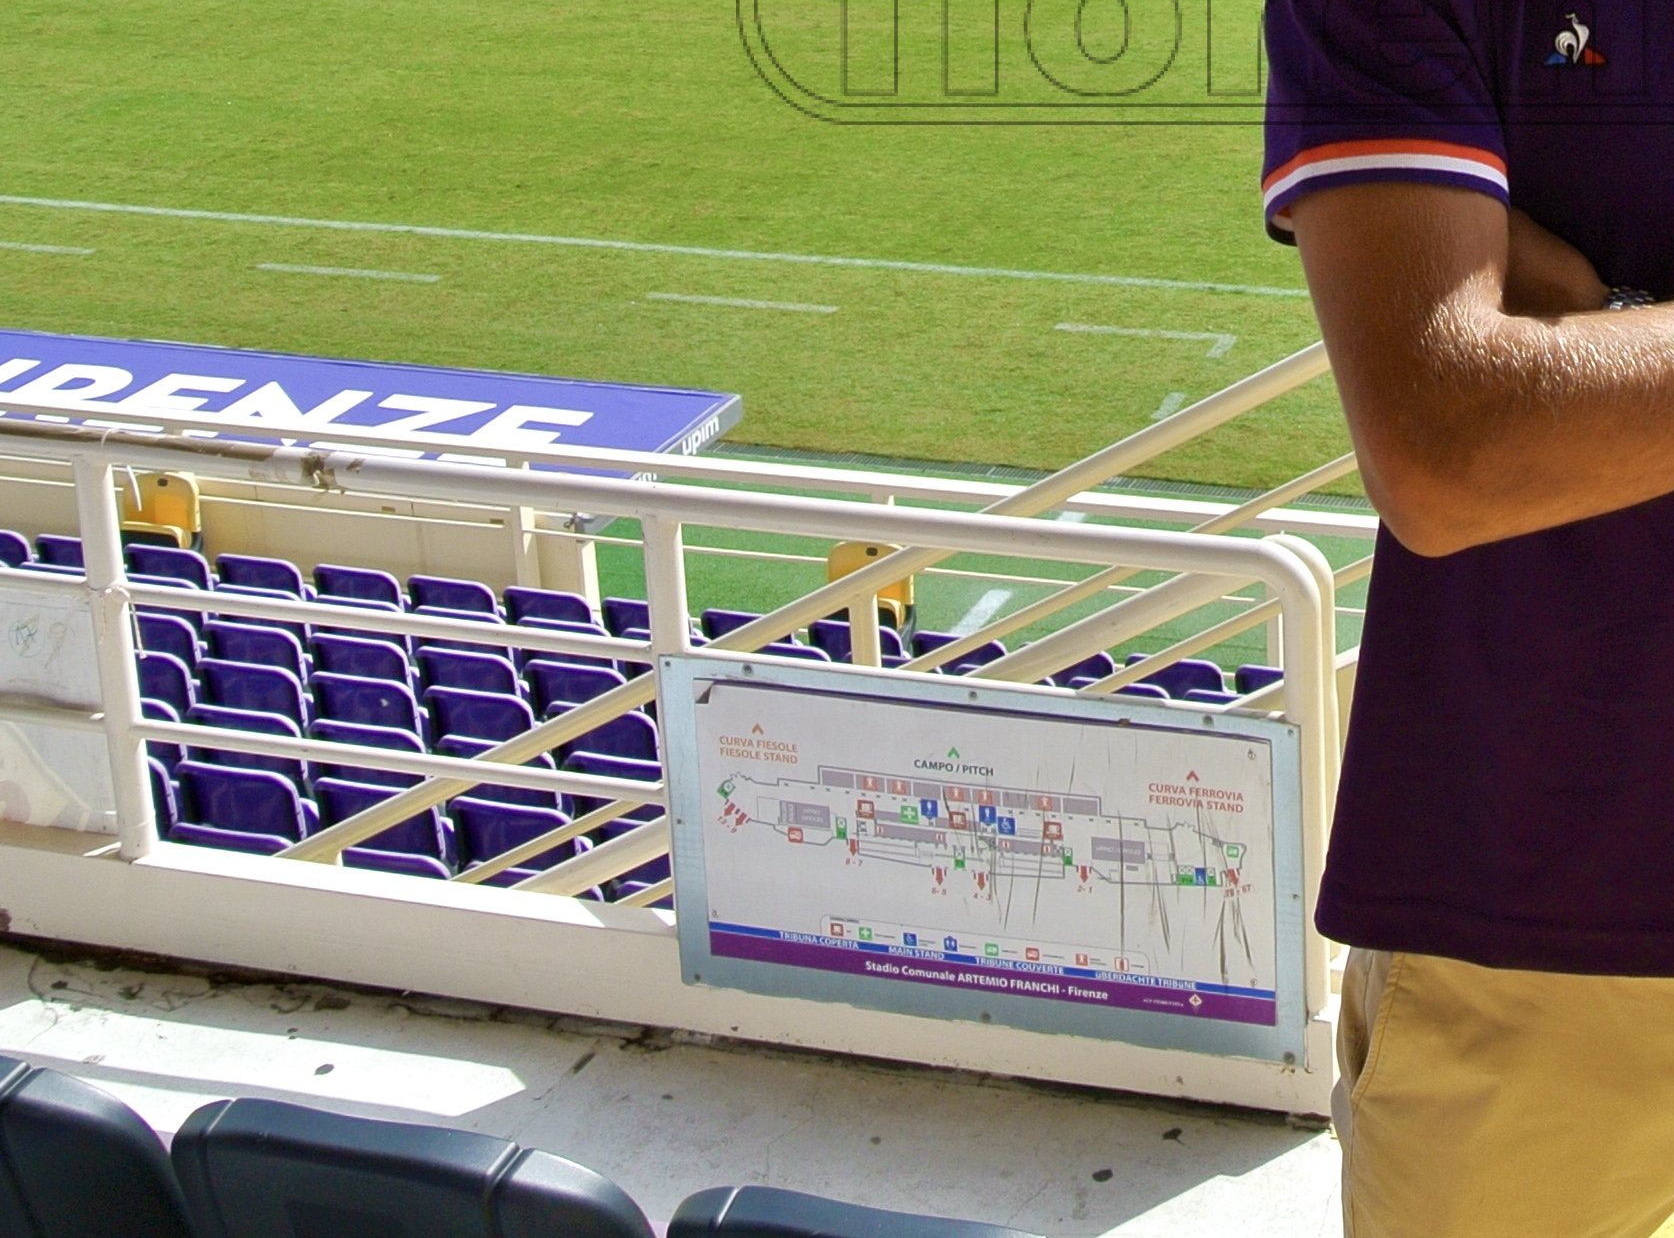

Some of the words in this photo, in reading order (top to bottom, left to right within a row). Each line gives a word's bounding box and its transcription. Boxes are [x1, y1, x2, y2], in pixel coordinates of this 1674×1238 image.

[682, 415, 720, 456] upim
[720, 736, 754, 748] CURVA
[757, 740, 799, 753] FIESOLE
[720, 747, 761, 760] FIESOLE
[764, 752, 798, 764] STAND
[914, 759, 954, 772] CAMPO
[962, 765, 994, 776] PITCH
[1148, 782, 1186, 795] CURVA
[1189, 787, 1244, 802] FERROVIA
[1149, 794, 1204, 809] FERROVIA
[1206, 800, 1244, 813] STAND
[779, 930, 817, 945] TRIBUNA
[819, 936, 859, 949] COPERTA
[888, 945, 913, 956] MAIN
[915, 948, 945, 960] STAND
[975, 958, 1014, 969] TRIBUNE
[1016, 963, 1064, 974] COUVERTE
[865, 961, 899, 974] Stadio
[901, 965, 955, 981] Comunale
[957, 973, 1008, 987] ARTEMIO
[1010, 979, 1059, 994] FRANCHI
[1068, 987, 1108, 999] Firenze
